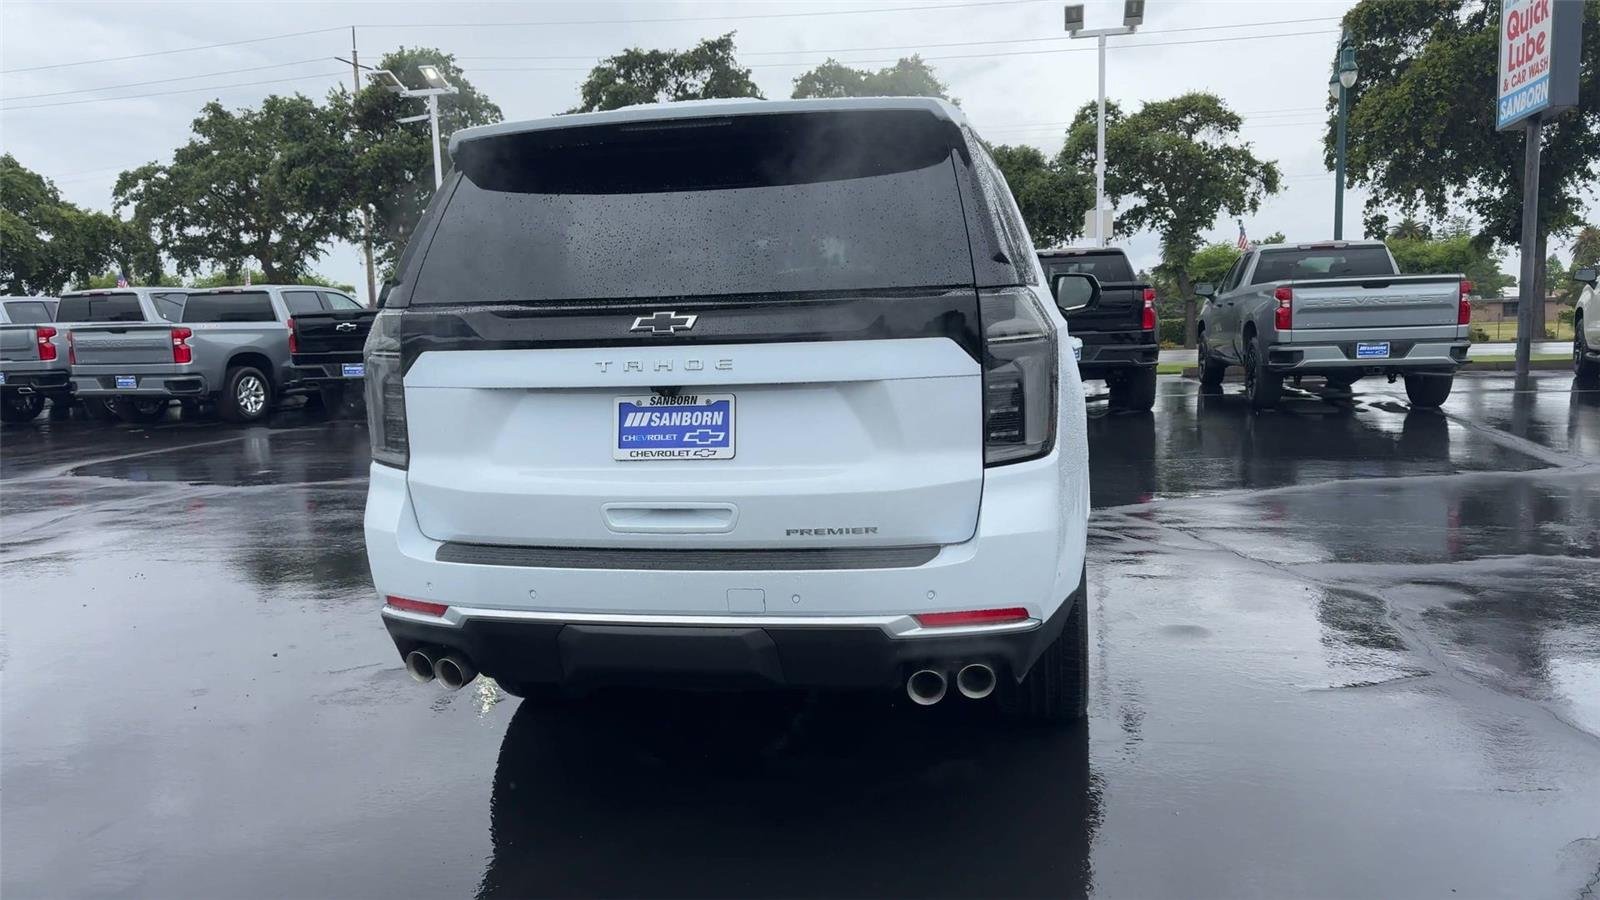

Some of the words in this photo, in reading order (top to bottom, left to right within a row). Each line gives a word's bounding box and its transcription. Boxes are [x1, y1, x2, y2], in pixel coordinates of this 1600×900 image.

[1507, 0, 1549, 40] Quick
[1508, 31, 1546, 72] Lube
[1503, 79, 1509, 92] &
[1511, 69, 1526, 87] CAR
[1529, 56, 1549, 79] WASH
[1501, 79, 1549, 121] SANBORN
[595, 359, 733, 373] TAHOE
[649, 395, 698, 406] SANBORN
[651, 411, 724, 427] SANBORN
[622, 433, 678, 442] CHEVROLET
[629, 450, 690, 458] CHEVROLET
[785, 527, 879, 536] PREMIER
